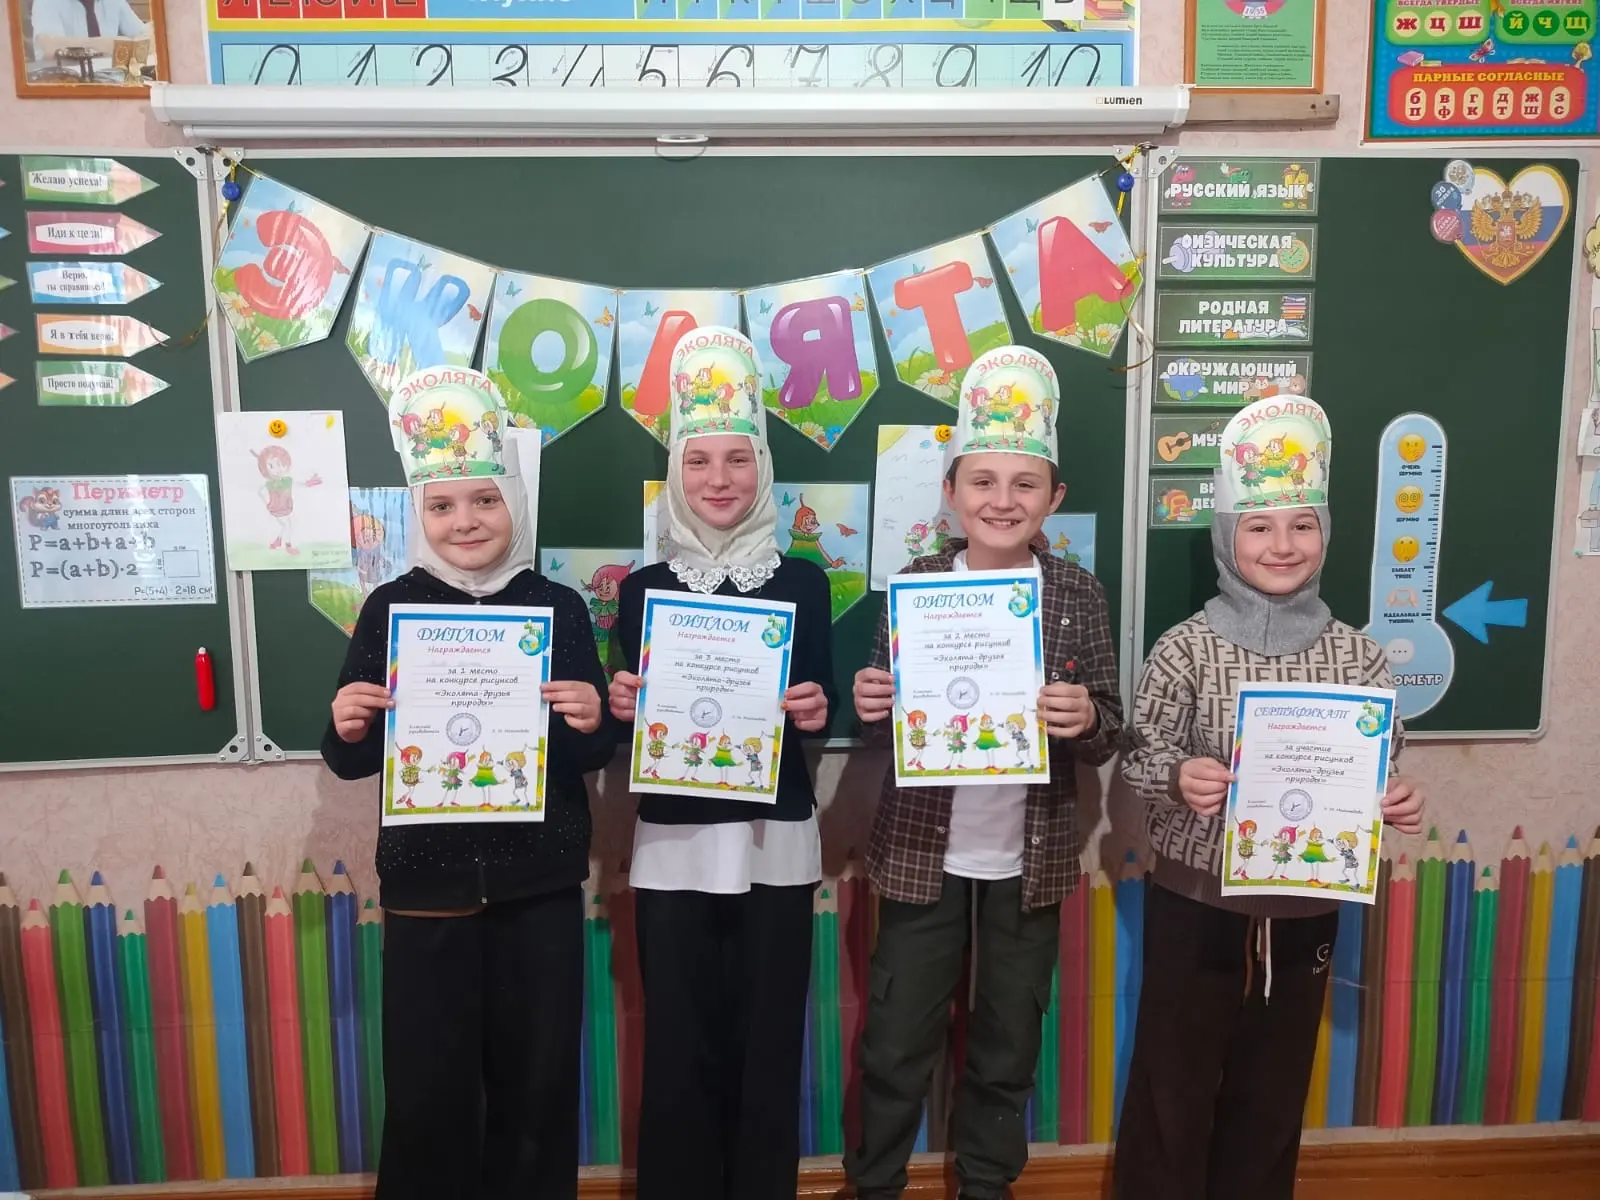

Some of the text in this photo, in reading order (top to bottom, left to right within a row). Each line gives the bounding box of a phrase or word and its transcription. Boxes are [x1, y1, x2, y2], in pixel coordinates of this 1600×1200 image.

[1413, 72, 1565, 82] ПАРНЫЕ СОГЛАСНЫЕ
[32, 172, 102, 188] Желаю успеха!
[1170, 181, 1305, 198] РУССКИЙ ЯЗЫК
[47, 227, 67, 239] Иди
[69, 229, 75, 238] к
[1182, 234, 1292, 249] ФИЗИЧЕСКАЯ
[1191, 254, 1281, 268] КУЛЬТУРА
[1199, 301, 1270, 315] РОДНАЯ
[1178, 319, 1288, 334] ЛИТЕРАТУРА
[50, 329, 57, 339] Я
[676, 335, 753, 360] ЭКОЛЯТА
[976, 353, 1053, 381] ЭКОЛЯТА
[1167, 360, 1297, 377] ОКРУЖАЮЩИЙ
[47, 378, 76, 390] Просто
[400, 371, 493, 401] ЭКОЛЯТА
[1213, 381, 1250, 394] МИР
[1237, 402, 1324, 432] ЭКОЛЯТА
[63, 508, 98, 518] сумма
[100, 508, 129, 517] длин
[158, 507, 196, 517] сторон
[912, 592, 995, 609] ДИПЛОМ
[923, 612, 983, 621] Награждается
[669, 613, 751, 633] ДИПЛОМ
[417, 627, 507, 643] ДИПЛОМ
[678, 631, 736, 643] Награждается
[963, 631, 991, 639] место
[428, 646, 492, 655] Награждается
[936, 641, 972, 650] конкурсе
[974, 639, 1011, 650] рисунков
[714, 655, 741, 663] место
[686, 662, 721, 671] конкурсе
[723, 666, 760, 674] рисунков
[426, 676, 519, 686] на конкурсе рисунков
[1393, 674, 1444, 686] ОМЕТР
[1254, 705, 1350, 720] СЕРТИФИКАТ
[1267, 723, 1327, 732] Награждается
[1296, 745, 1332, 753] участие
[1275, 753, 1313, 762] конкурсе
[1314, 754, 1354, 764] рисунков
